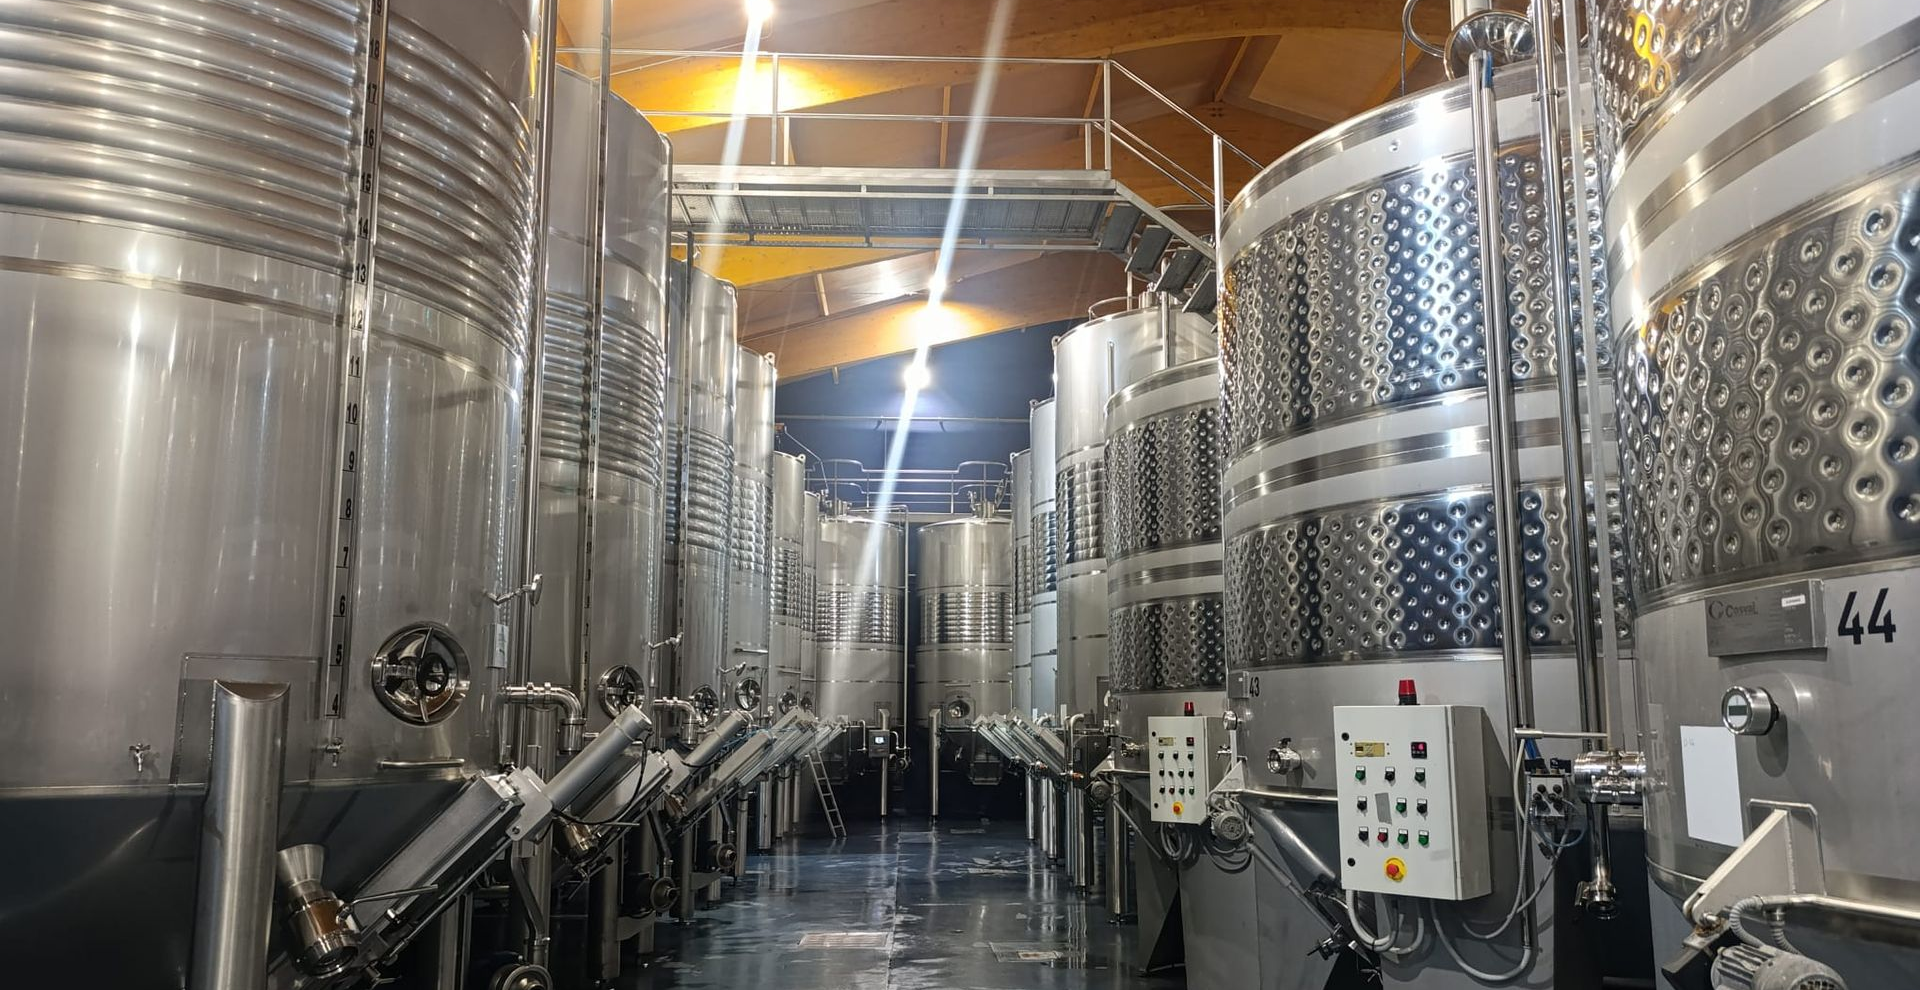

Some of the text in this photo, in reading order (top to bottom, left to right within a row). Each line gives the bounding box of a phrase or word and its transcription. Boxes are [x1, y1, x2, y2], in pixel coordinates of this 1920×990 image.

[371, 0, 382, 14] 19
[369, 38, 380, 59] 18
[367, 82, 378, 104] 17
[363, 128, 375, 148] 16
[360, 172, 372, 192] 15
[358, 217, 369, 238] 14
[355, 263, 367, 283] 13
[352, 308, 363, 330] 12
[350, 355, 361, 377] 11
[346, 402, 358, 424] 10
[348, 451, 355, 470] 9
[345, 498, 352, 518] 8
[343, 546, 349, 568] 7
[339, 595, 346, 616] 6
[1837, 587, 1897, 645] 44
[335, 644, 343, 665] 5
[1249, 676, 1261, 697] 43
[331, 693, 339, 714] 4
